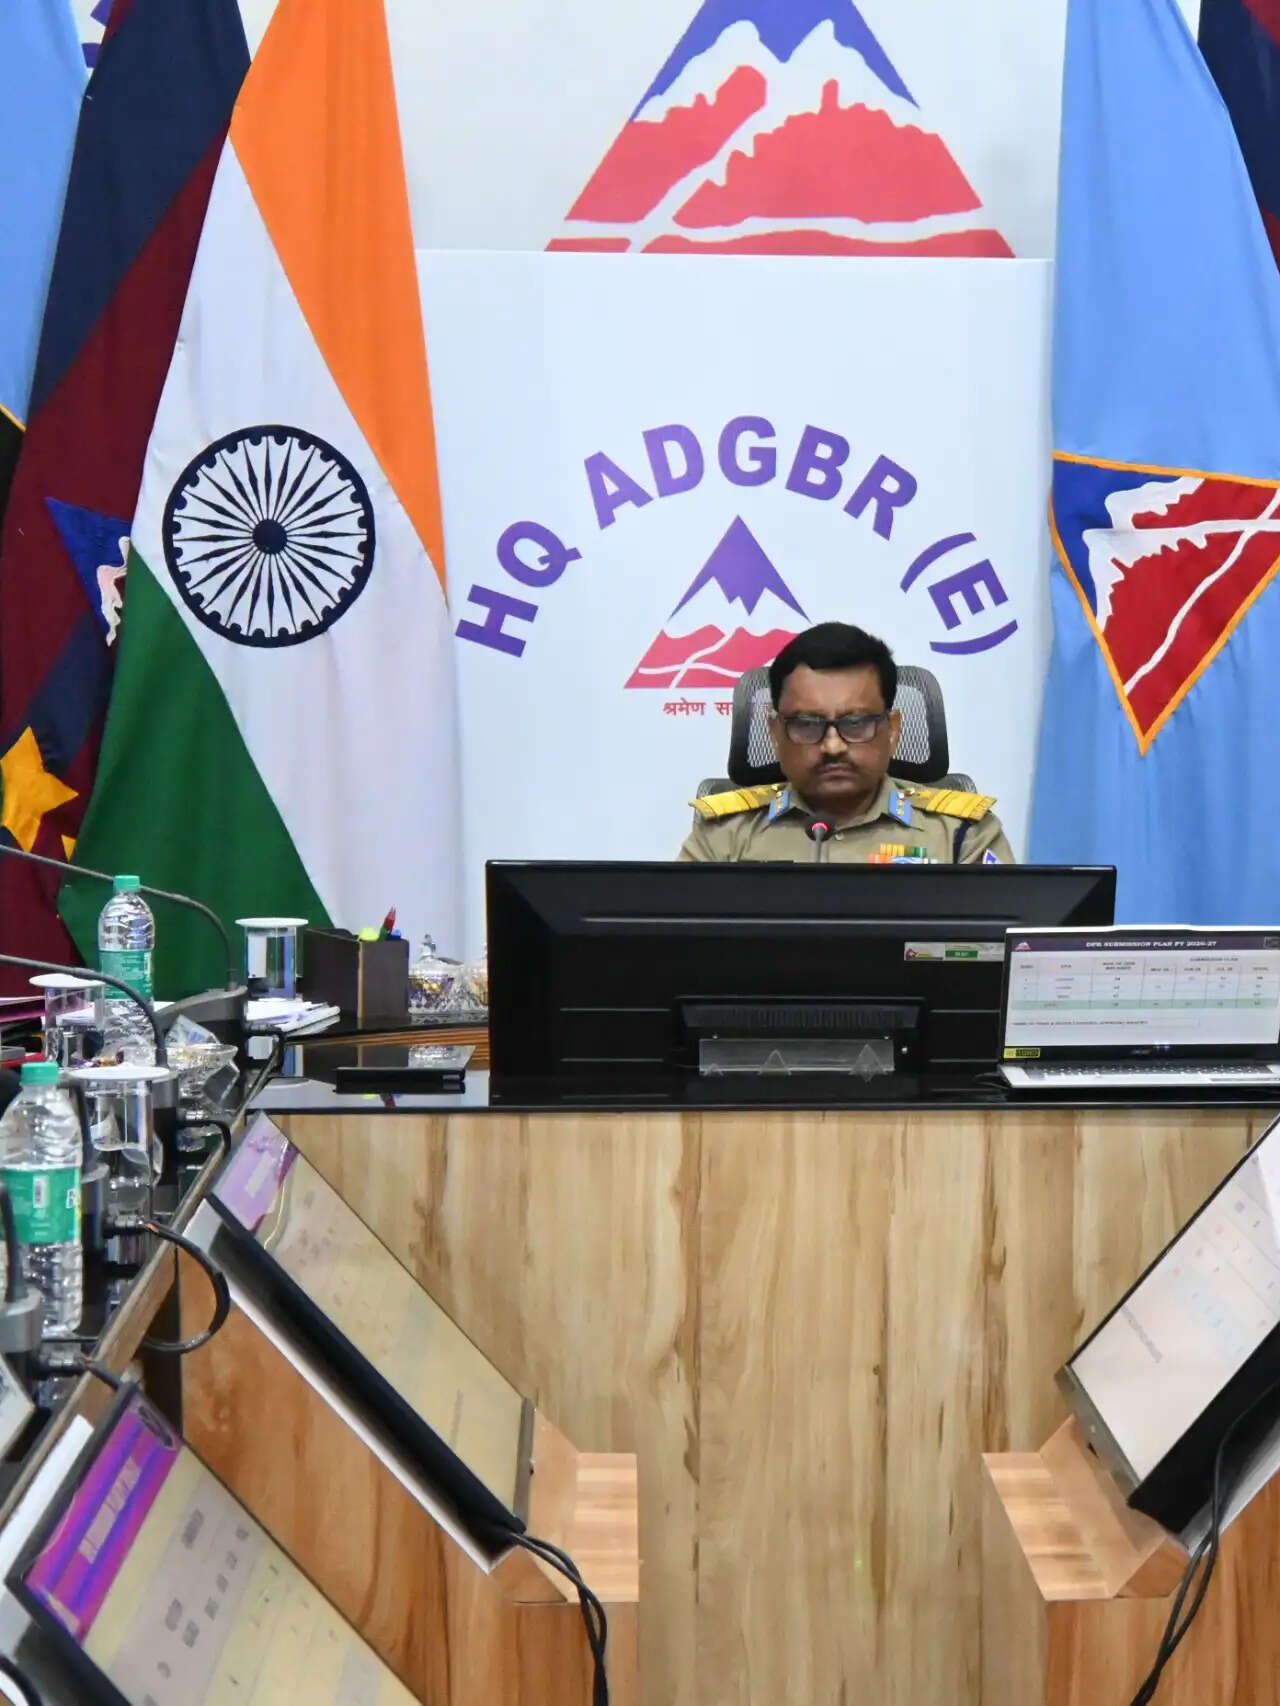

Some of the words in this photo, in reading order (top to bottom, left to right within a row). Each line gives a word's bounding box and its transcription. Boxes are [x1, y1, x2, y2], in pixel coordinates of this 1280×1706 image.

[455, 520, 583, 659] HQ
[583, 415, 918, 542] ADGBR
[900, 531, 1019, 656] (E)
[662, 696, 707, 716] श्रमेण
